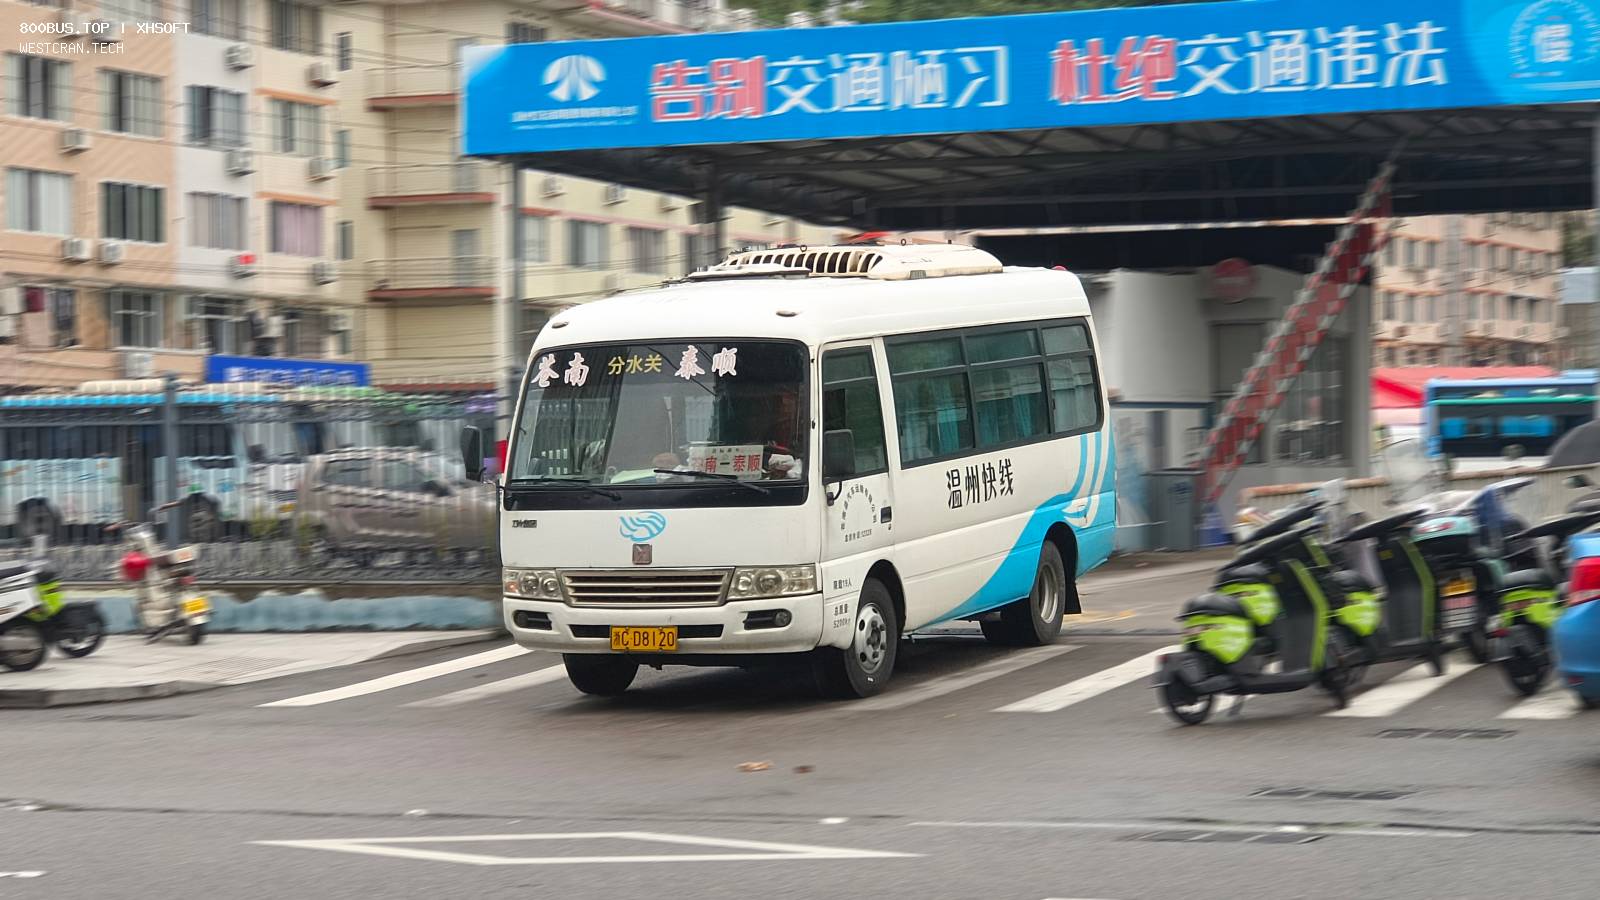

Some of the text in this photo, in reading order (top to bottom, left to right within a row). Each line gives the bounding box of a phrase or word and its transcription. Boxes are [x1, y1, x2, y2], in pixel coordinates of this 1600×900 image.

[648, 20, 1448, 123] 告别交通陋习 杜绝交通违法
[530, 344, 738, 388] 苍南 分水关 泰顺
[946, 458, 1014, 509] 温州快线
